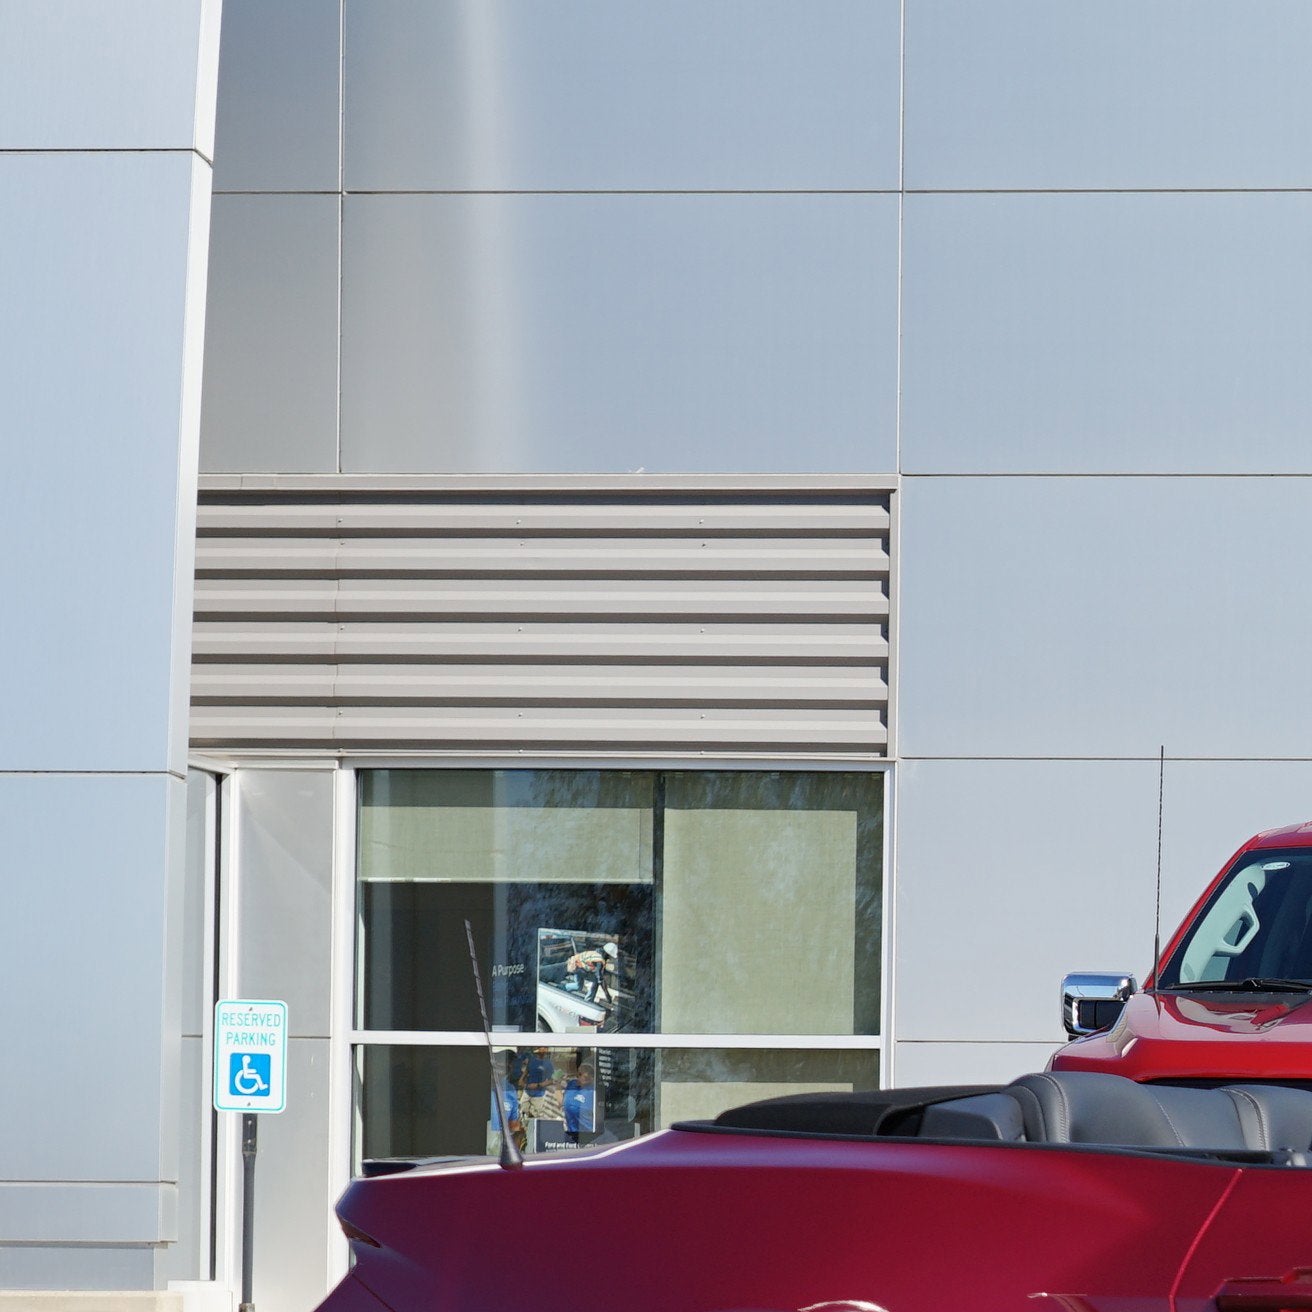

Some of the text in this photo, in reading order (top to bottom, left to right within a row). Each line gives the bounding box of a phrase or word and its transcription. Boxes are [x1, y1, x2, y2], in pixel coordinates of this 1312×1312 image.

[498, 964, 524, 977] Purpose
[221, 1013, 281, 1027] RESERVED
[225, 1032, 276, 1046] PARKING
